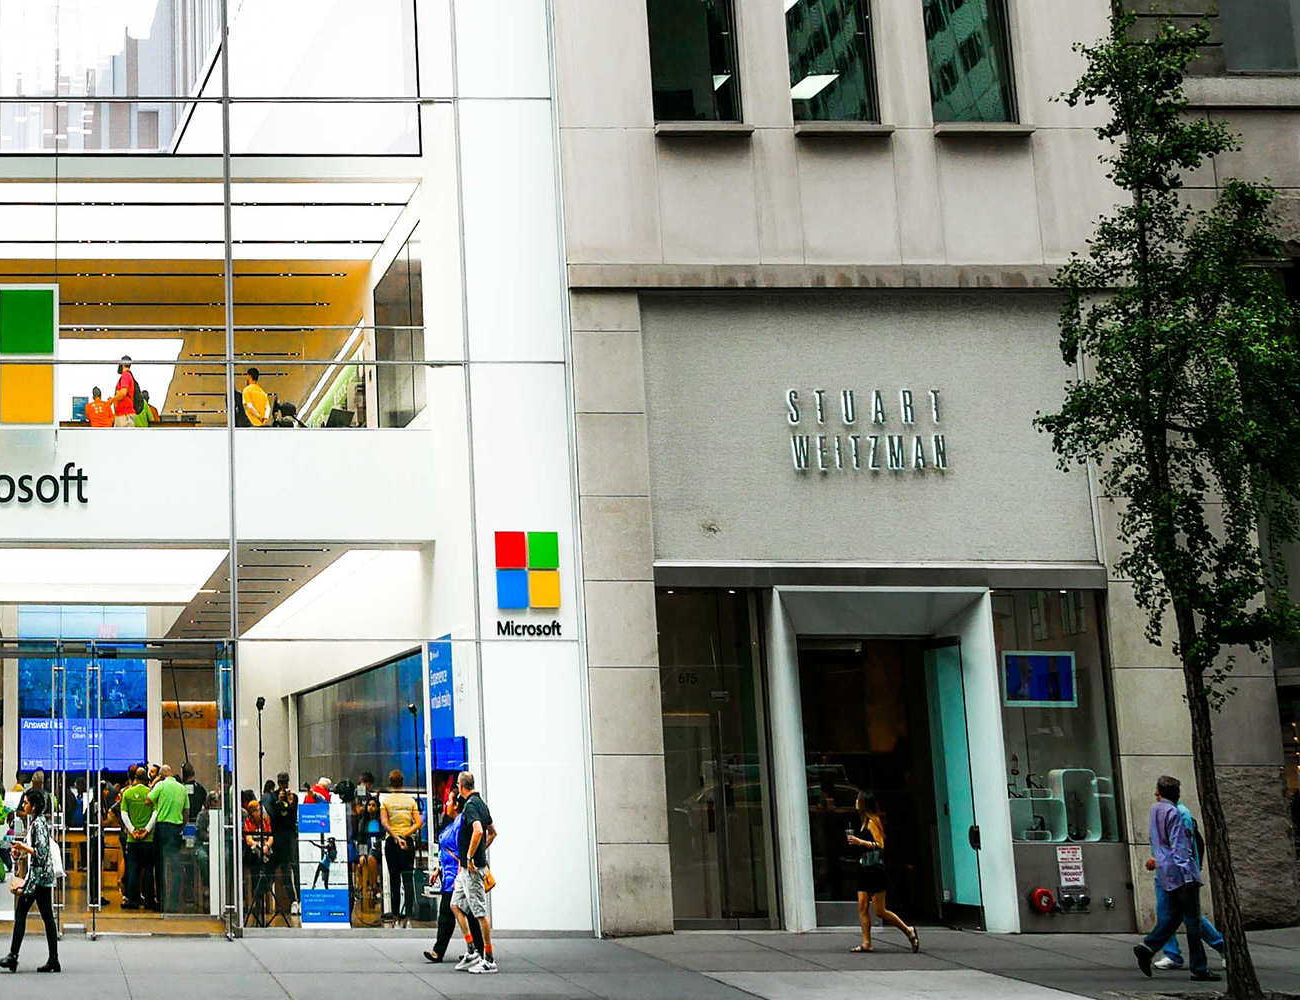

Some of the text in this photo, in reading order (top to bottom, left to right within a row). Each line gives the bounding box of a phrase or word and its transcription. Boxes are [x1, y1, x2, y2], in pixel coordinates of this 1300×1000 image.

[786, 388, 941, 425] STUART
[791, 434, 947, 470] WEITZMAN
[497, 620, 562, 636] Microsoft
[677, 672, 698, 685] 675
[162, 711, 204, 719] ALO 5
